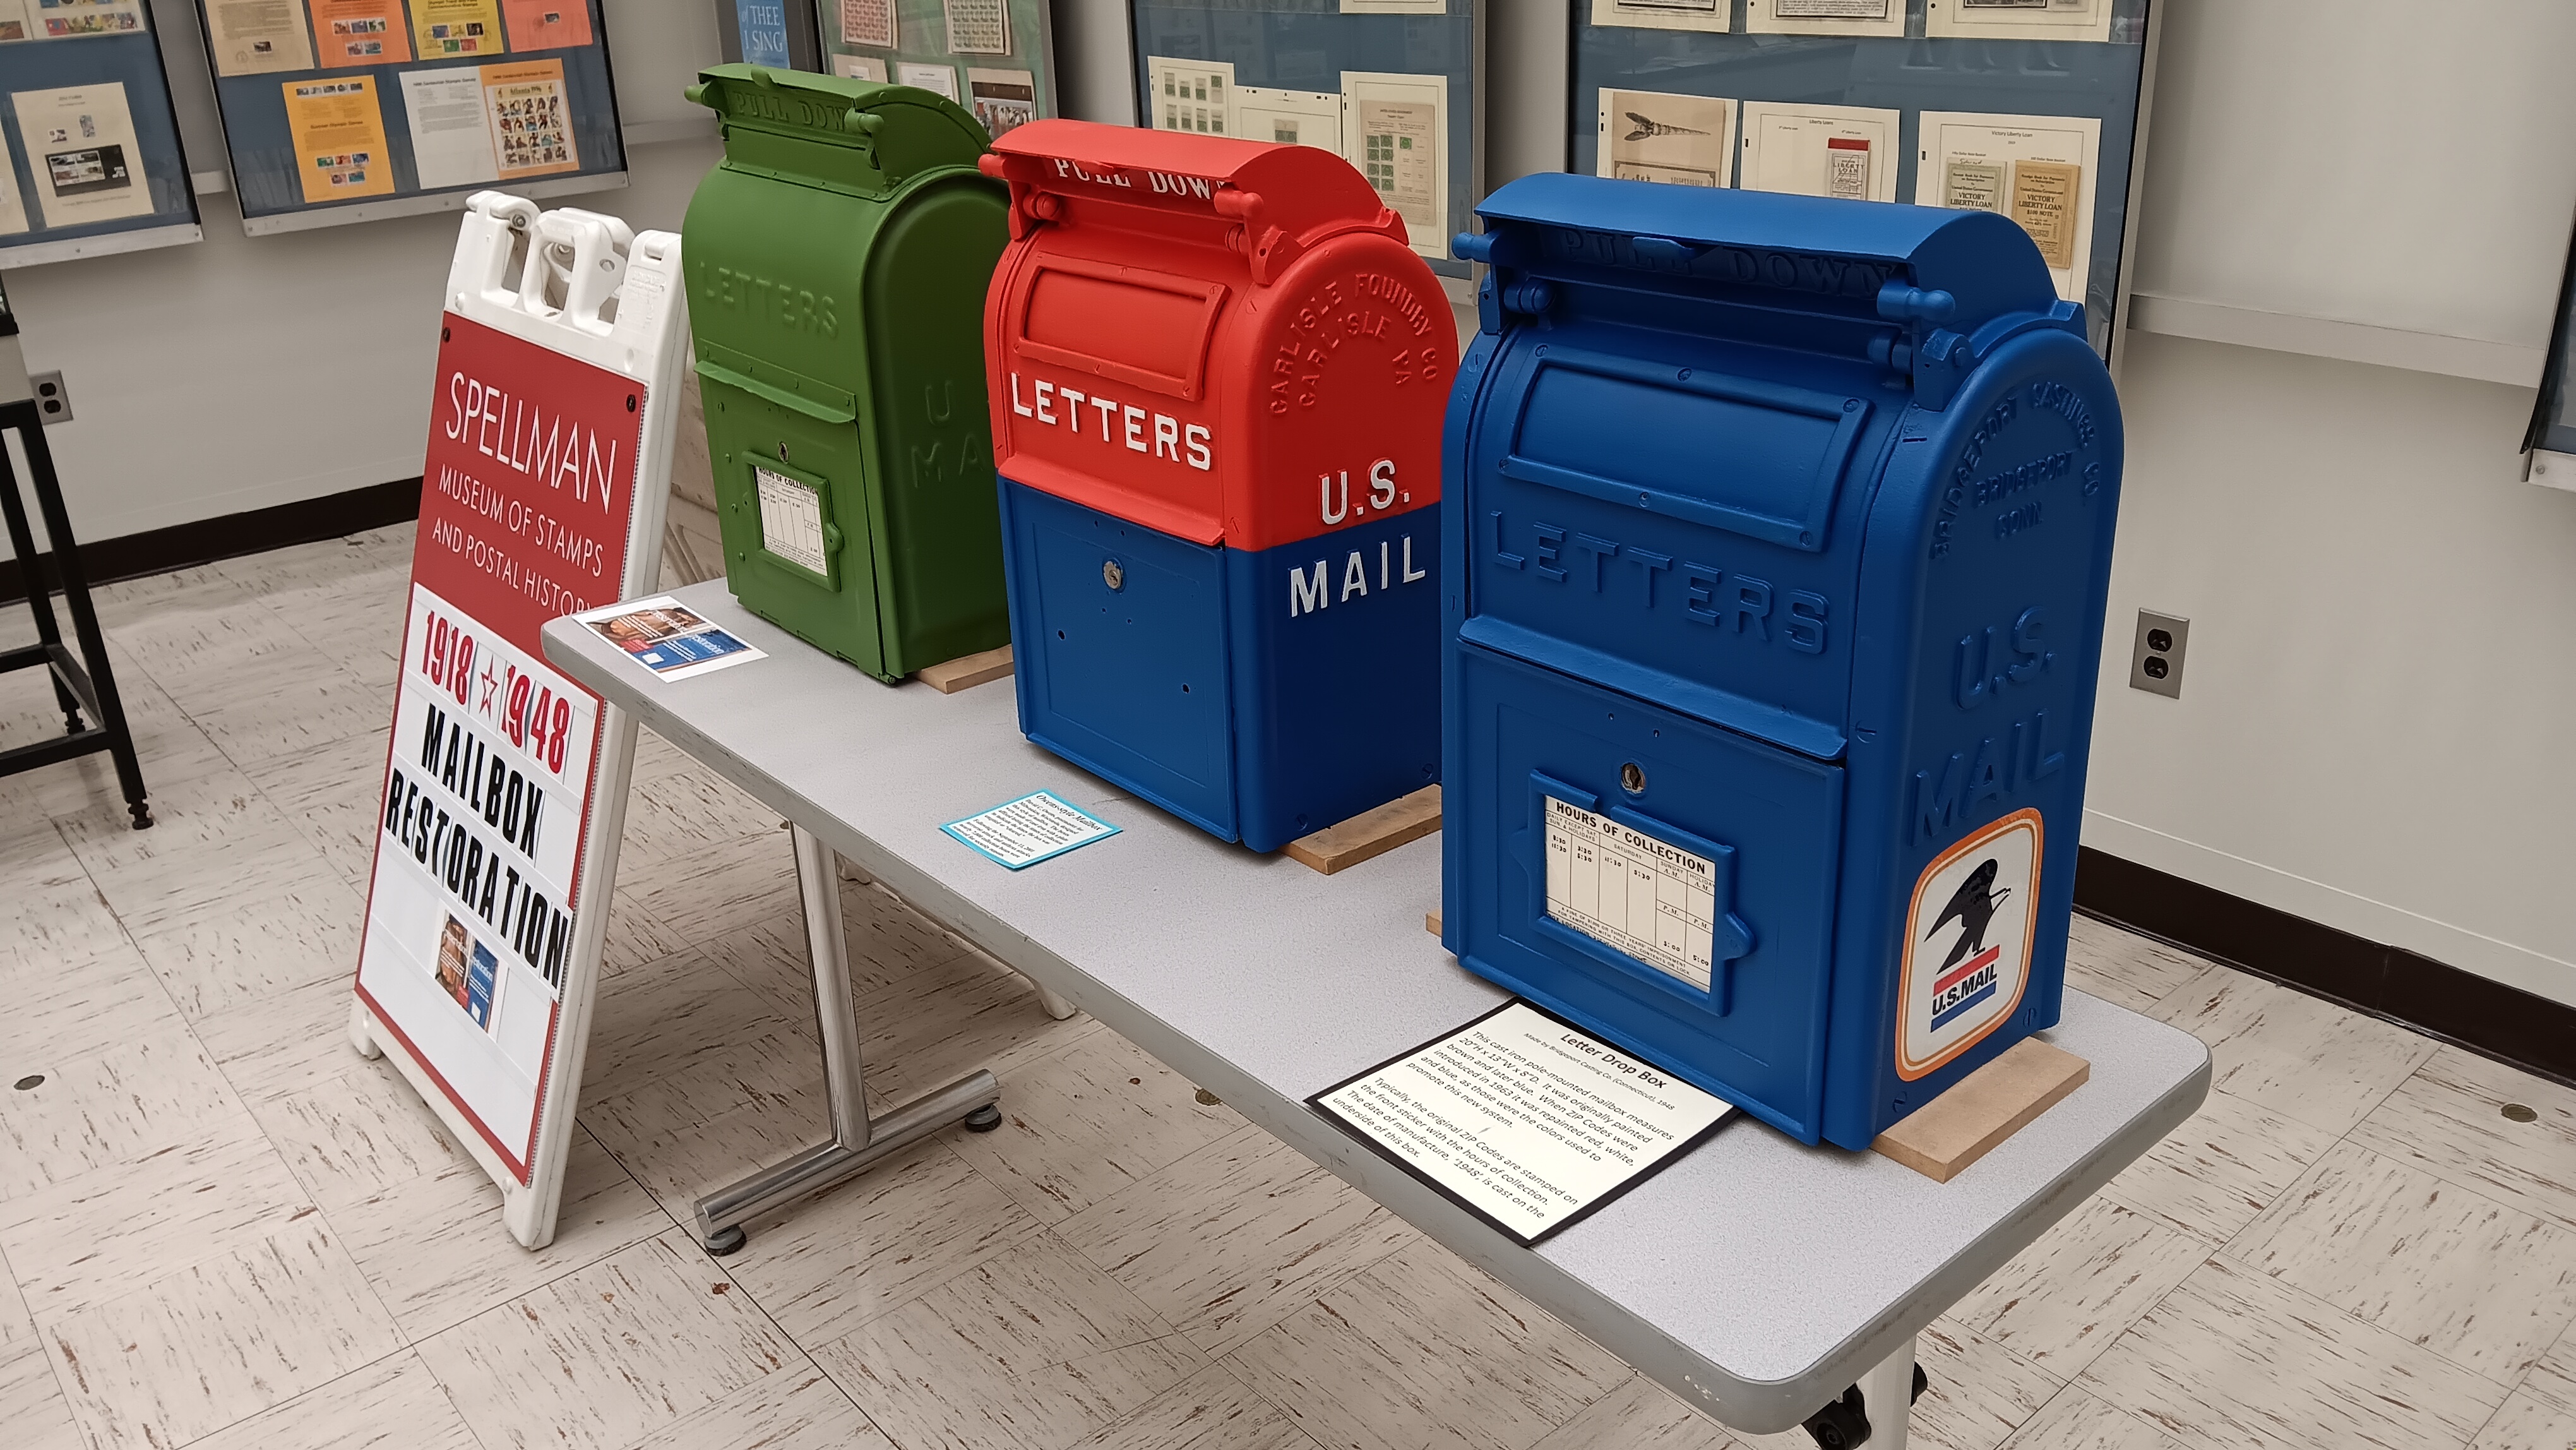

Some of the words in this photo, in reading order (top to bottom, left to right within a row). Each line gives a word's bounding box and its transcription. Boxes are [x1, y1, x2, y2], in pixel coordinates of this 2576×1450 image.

[744, 29, 749, 50] I
[752, 30, 783, 52] SING
[749, 5, 780, 25] THEE
[798, 100, 845, 132] DOW
[1147, 171, 1225, 200] DOW
[2018, 201, 2044, 209] LIBERTY
[2044, 203, 2062, 211] LOAN
[700, 261, 838, 339] LETTERS
[1270, 281, 1342, 414] CARLISLE
[1355, 273, 1432, 336] FOUNDRY
[1421, 347, 1438, 380] CO
[1299, 310, 1392, 407] CARLISLE
[445, 371, 617, 515] SPELLMAN
[911, 432, 986, 489] MA
[1011, 372, 1211, 471] LETTERS
[438, 463, 504, 524] MUSEUM
[508, 500, 533, 537] OF
[535, 514, 604, 578] STAMPS
[1319, 457, 1410, 525] U.S.
[432, 517, 463, 553] AND
[466, 534, 519, 590] POSTAL
[1289, 534, 1426, 618] MAIL
[1489, 510, 1829, 656] LETTERS
[422, 610, 474, 705] 1918
[501, 665, 569, 774] 1948
[1955, 606, 2057, 710] U.S.
[421, 703, 544, 860] MAILBOX
[1910, 708, 2066, 847] MAIL
[1547, 812, 1562, 822] DAILY
[1565, 819, 1583, 832] EXCEPT
[1556, 801, 1596, 827] HOURS
[1602, 822, 1618, 836] OF
[1625, 832, 1705, 875] COLLECTION
[1568, 826, 1595, 841] HOLIDAYS
[1614, 843, 1641, 860] SATURDAY
[385, 767, 569, 990] RESTORATION
[1660, 861, 1683, 873] SUNDAY
[1405, 1062, 1444, 1086] promote
[1444, 1084, 1462, 1095] this
[1460, 1094, 1482, 1107] new
[1479, 1106, 1512, 1127] system.
[1446, 1043, 1474, 1060] brown
[1474, 1060, 1494, 1070] and
[1491, 1068, 1513, 1082] later
[1512, 1080, 1533, 1096] blue.
[1539, 1094, 1566, 1112] When
[1565, 1110, 1583, 1119] ZIP
[1582, 1119, 1613, 1137] Codes
[1613, 1135, 1638, 1151] were
[1472, 1031, 1491, 1043] This
[1489, 1041, 1509, 1053] cast
[1507, 1050, 1526, 1062] iron
[1524, 1061, 1591, 1096] pole-mounted
[1588, 1094, 1627, 1115] mailbox
[1626, 1114, 1674, 1140] measures
[1524, 1033, 1541, 1043] Made
[1549, 1046, 1580, 1063] Bridgeport
[1580, 1062, 1602, 1075] Casting
[1656, 1099, 1674, 1110] 1948
[1559, 1034, 1602, 1055] Letter
[1601, 1053, 1637, 1074] Drop
[1637, 1070, 1667, 1088] Box
[1332, 1098, 1374, 1126] underside
[1384, 1132, 1402, 1144] this
[1401, 1142, 1420, 1157] box.
[1361, 1084, 1376, 1095] the
[1375, 1094, 1398, 1110] front
[1396, 1108, 1427, 1127] sticker
[1426, 1126, 1446, 1141] with
[1446, 1139, 1463, 1151] the
[1462, 1149, 1490, 1167] hours
[1501, 1174, 1547, 1205] collection.
[1374, 1077, 1410, 1103] Typically,
[1411, 1101, 1427, 1113] the
[1427, 1112, 1463, 1134] original
[1458, 1131, 1477, 1141] ZIP
[1476, 1142, 1505, 1160] Codes
[1503, 1159, 1520, 1170] are
[1520, 1170, 1565, 1195] stamped
[1421, 1057, 1441, 1067] and
[1437, 1065, 1457, 1081] blue,
[1470, 1085, 1496, 1101] those
[1496, 1100, 1519, 1115] were
[1519, 1113, 1536, 1124] the
[1536, 1123, 1565, 1140] colors
[1565, 1139, 1591, 1154] used
[1433, 1049, 1482, 1077] introduced
[1488, 1082, 1513, 1096] 1963
[1520, 1099, 1539, 1111] was
[1538, 1110, 1586, 1136] repainted
[1583, 1135, 1604, 1148] red,
[1605, 1146, 1633, 1166] white,
[1551, 1088, 1570, 1099] was
[1570, 1099, 1614, 1123] originally
[1611, 1122, 1653, 1142] painted
[1347, 1089, 1364, 1103] The
[1363, 1102, 1383, 1115] date
[1392, 1122, 1448, 1160] manufacture,
[1491, 1185, 1513, 1198] cast
[1526, 1205, 1544, 1218] the
